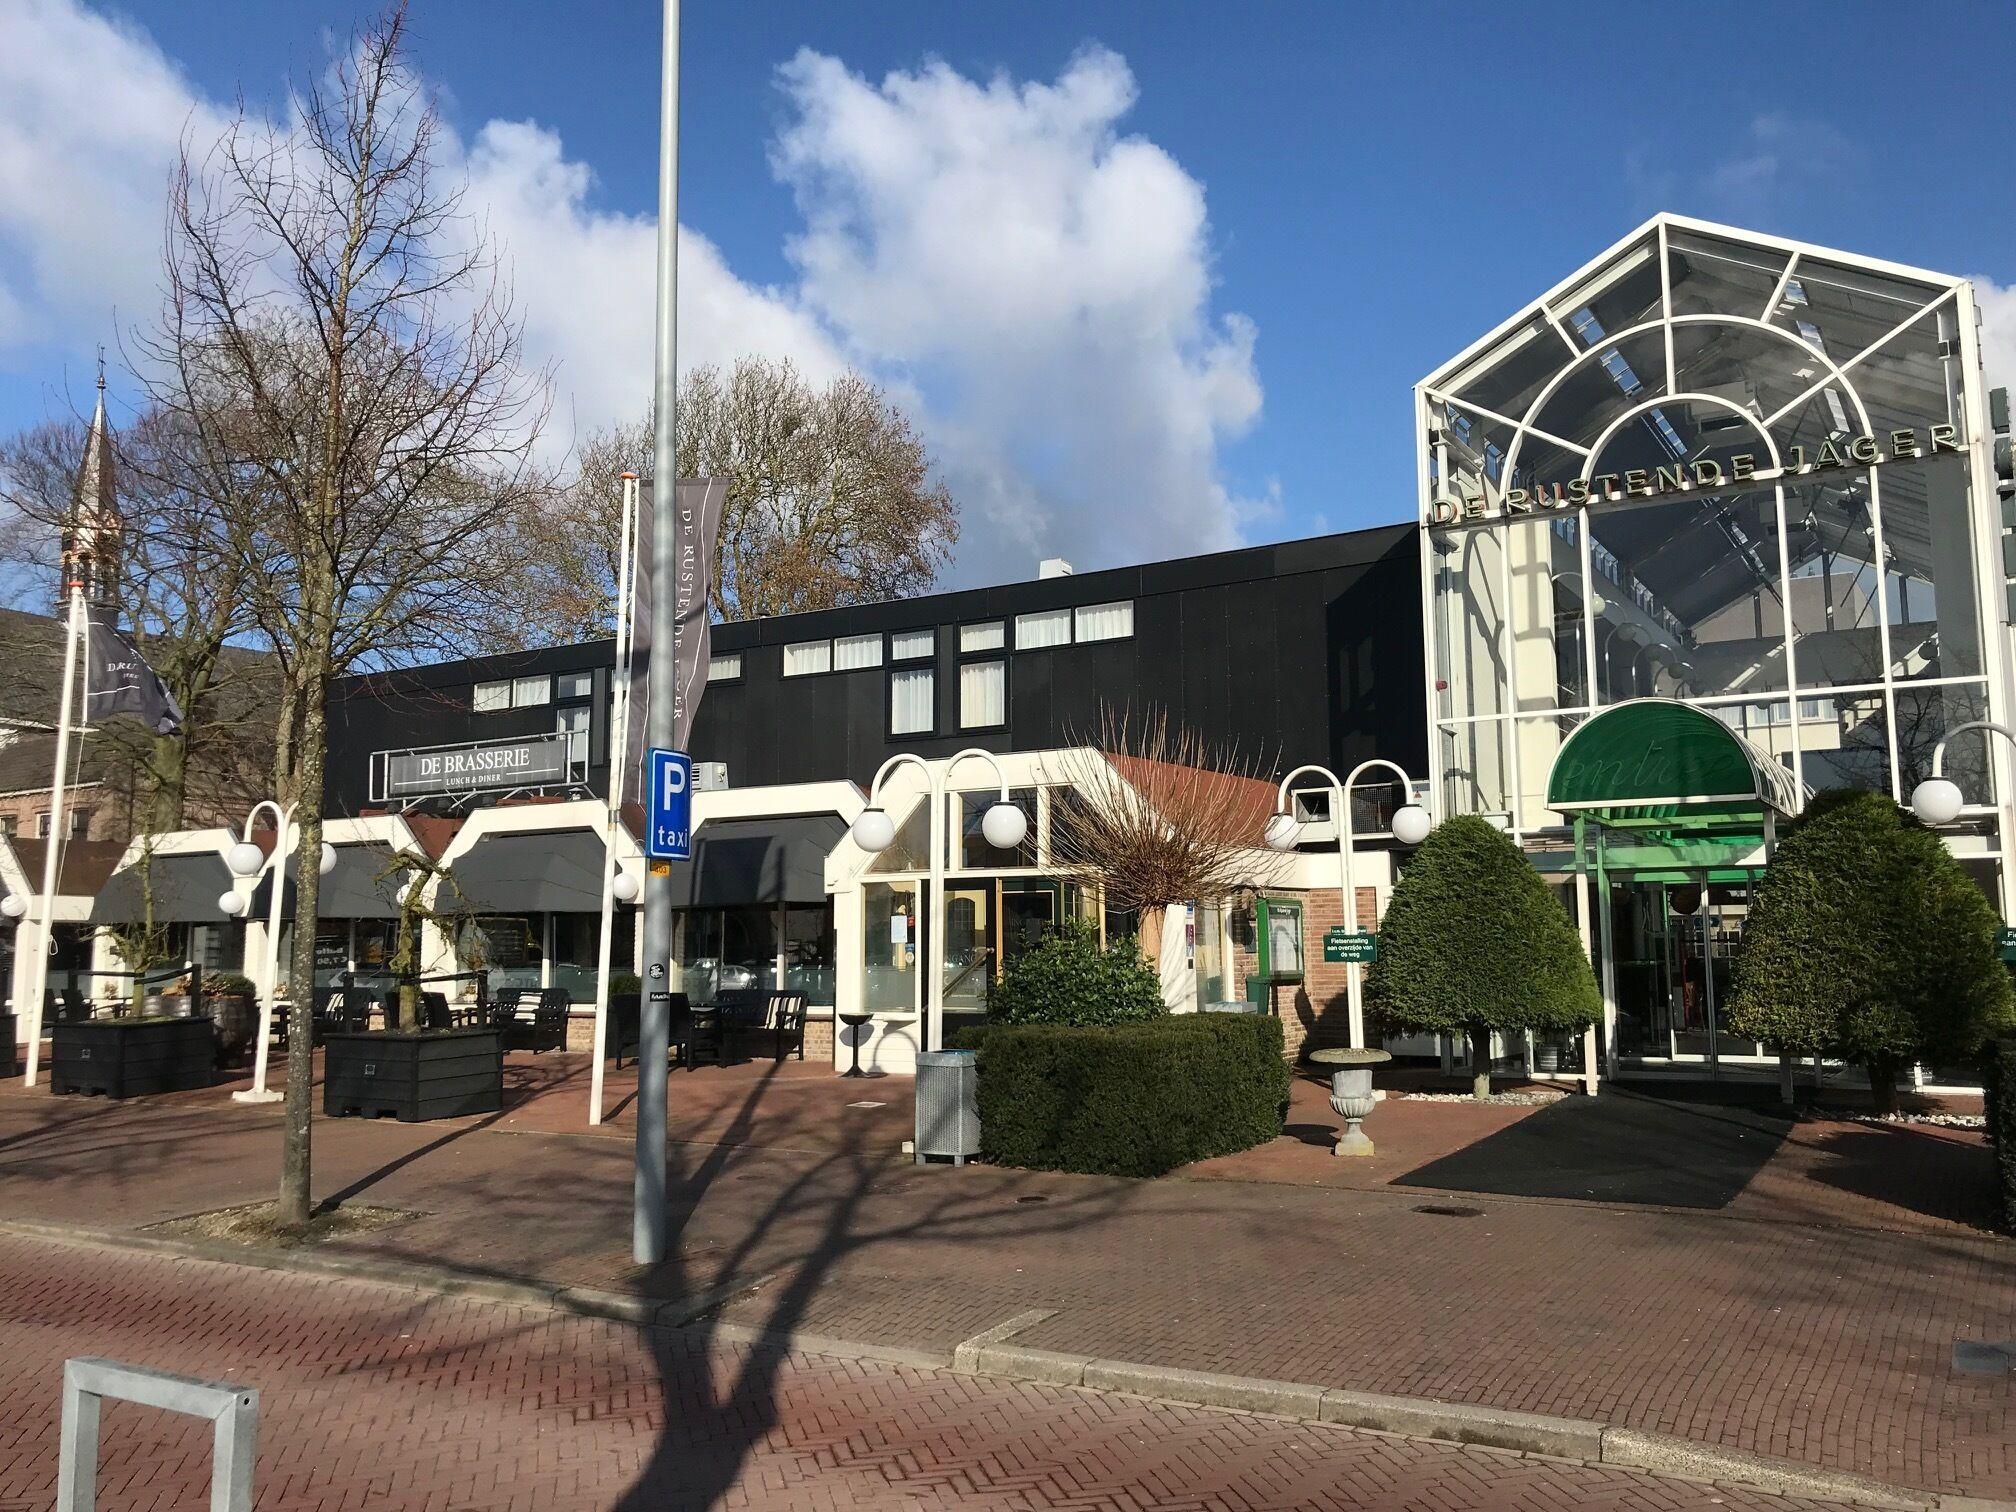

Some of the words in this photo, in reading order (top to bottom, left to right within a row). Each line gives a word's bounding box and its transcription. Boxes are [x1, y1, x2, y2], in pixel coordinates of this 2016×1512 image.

[1432, 494, 1486, 523] DE
[1505, 453, 1756, 514] RUSTENDE
[1784, 424, 1958, 474] JAGER
[681, 508, 694, 536] DE
[420, 757, 441, 776] DE
[444, 748, 531, 773] BRASSERIE
[446, 776, 471, 786] LUNCH
[478, 774, 501, 784] DINER
[664, 761, 686, 811] P
[658, 825, 688, 848] taxi
